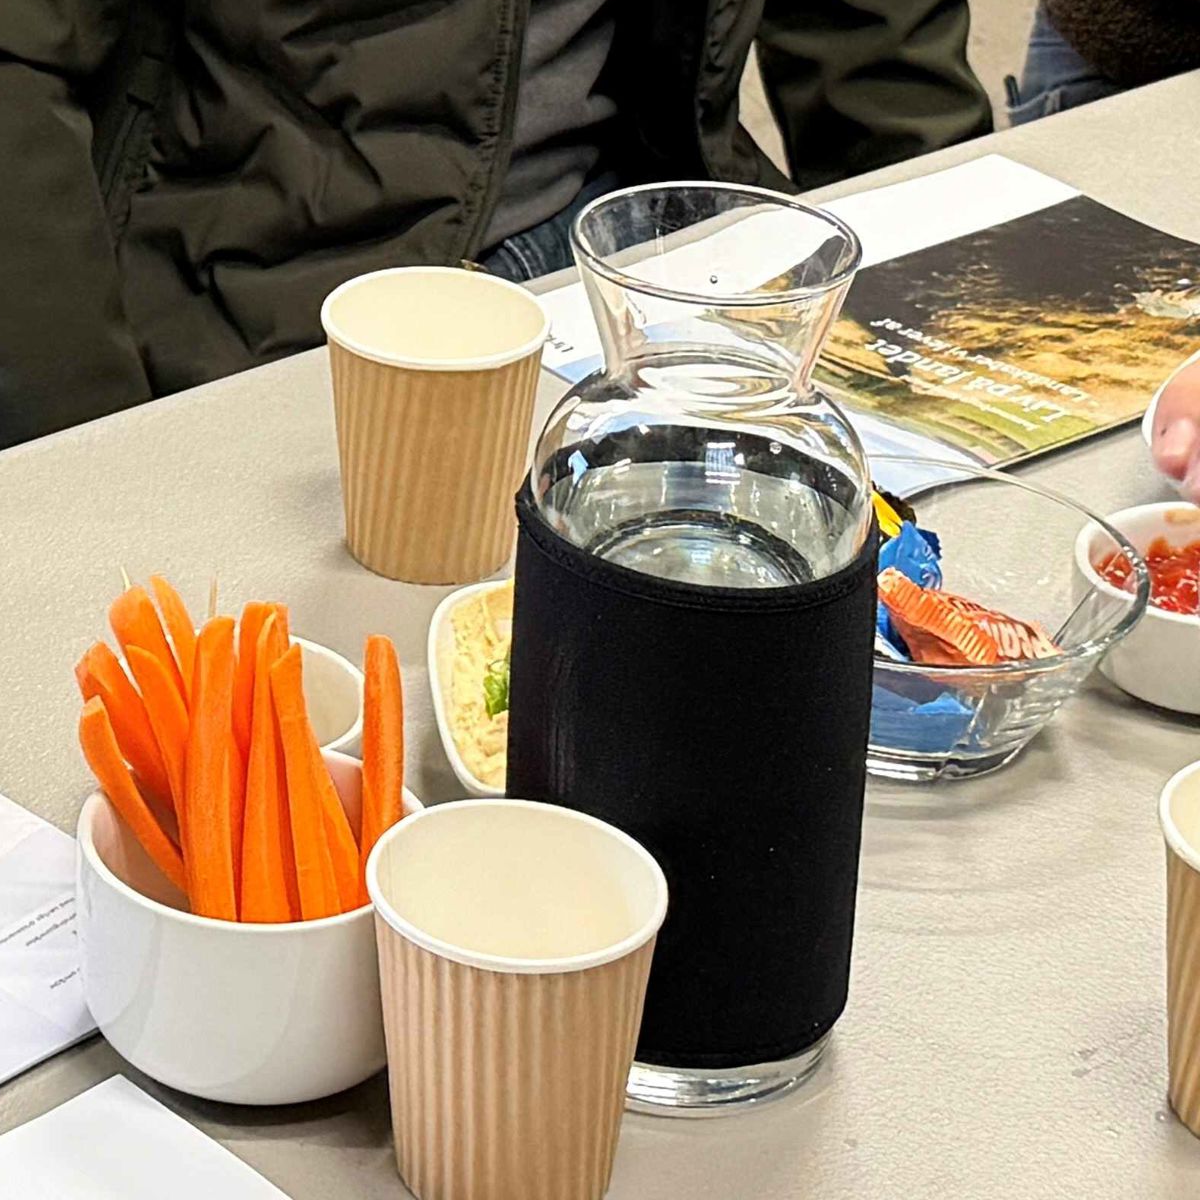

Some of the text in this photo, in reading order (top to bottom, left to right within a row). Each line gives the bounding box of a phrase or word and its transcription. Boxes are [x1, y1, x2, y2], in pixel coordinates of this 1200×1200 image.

[869, 318, 903, 331] af
[864, 339, 976, 385] landet
[962, 376, 1022, 396] på
[1008, 394, 1067, 422] Liv
